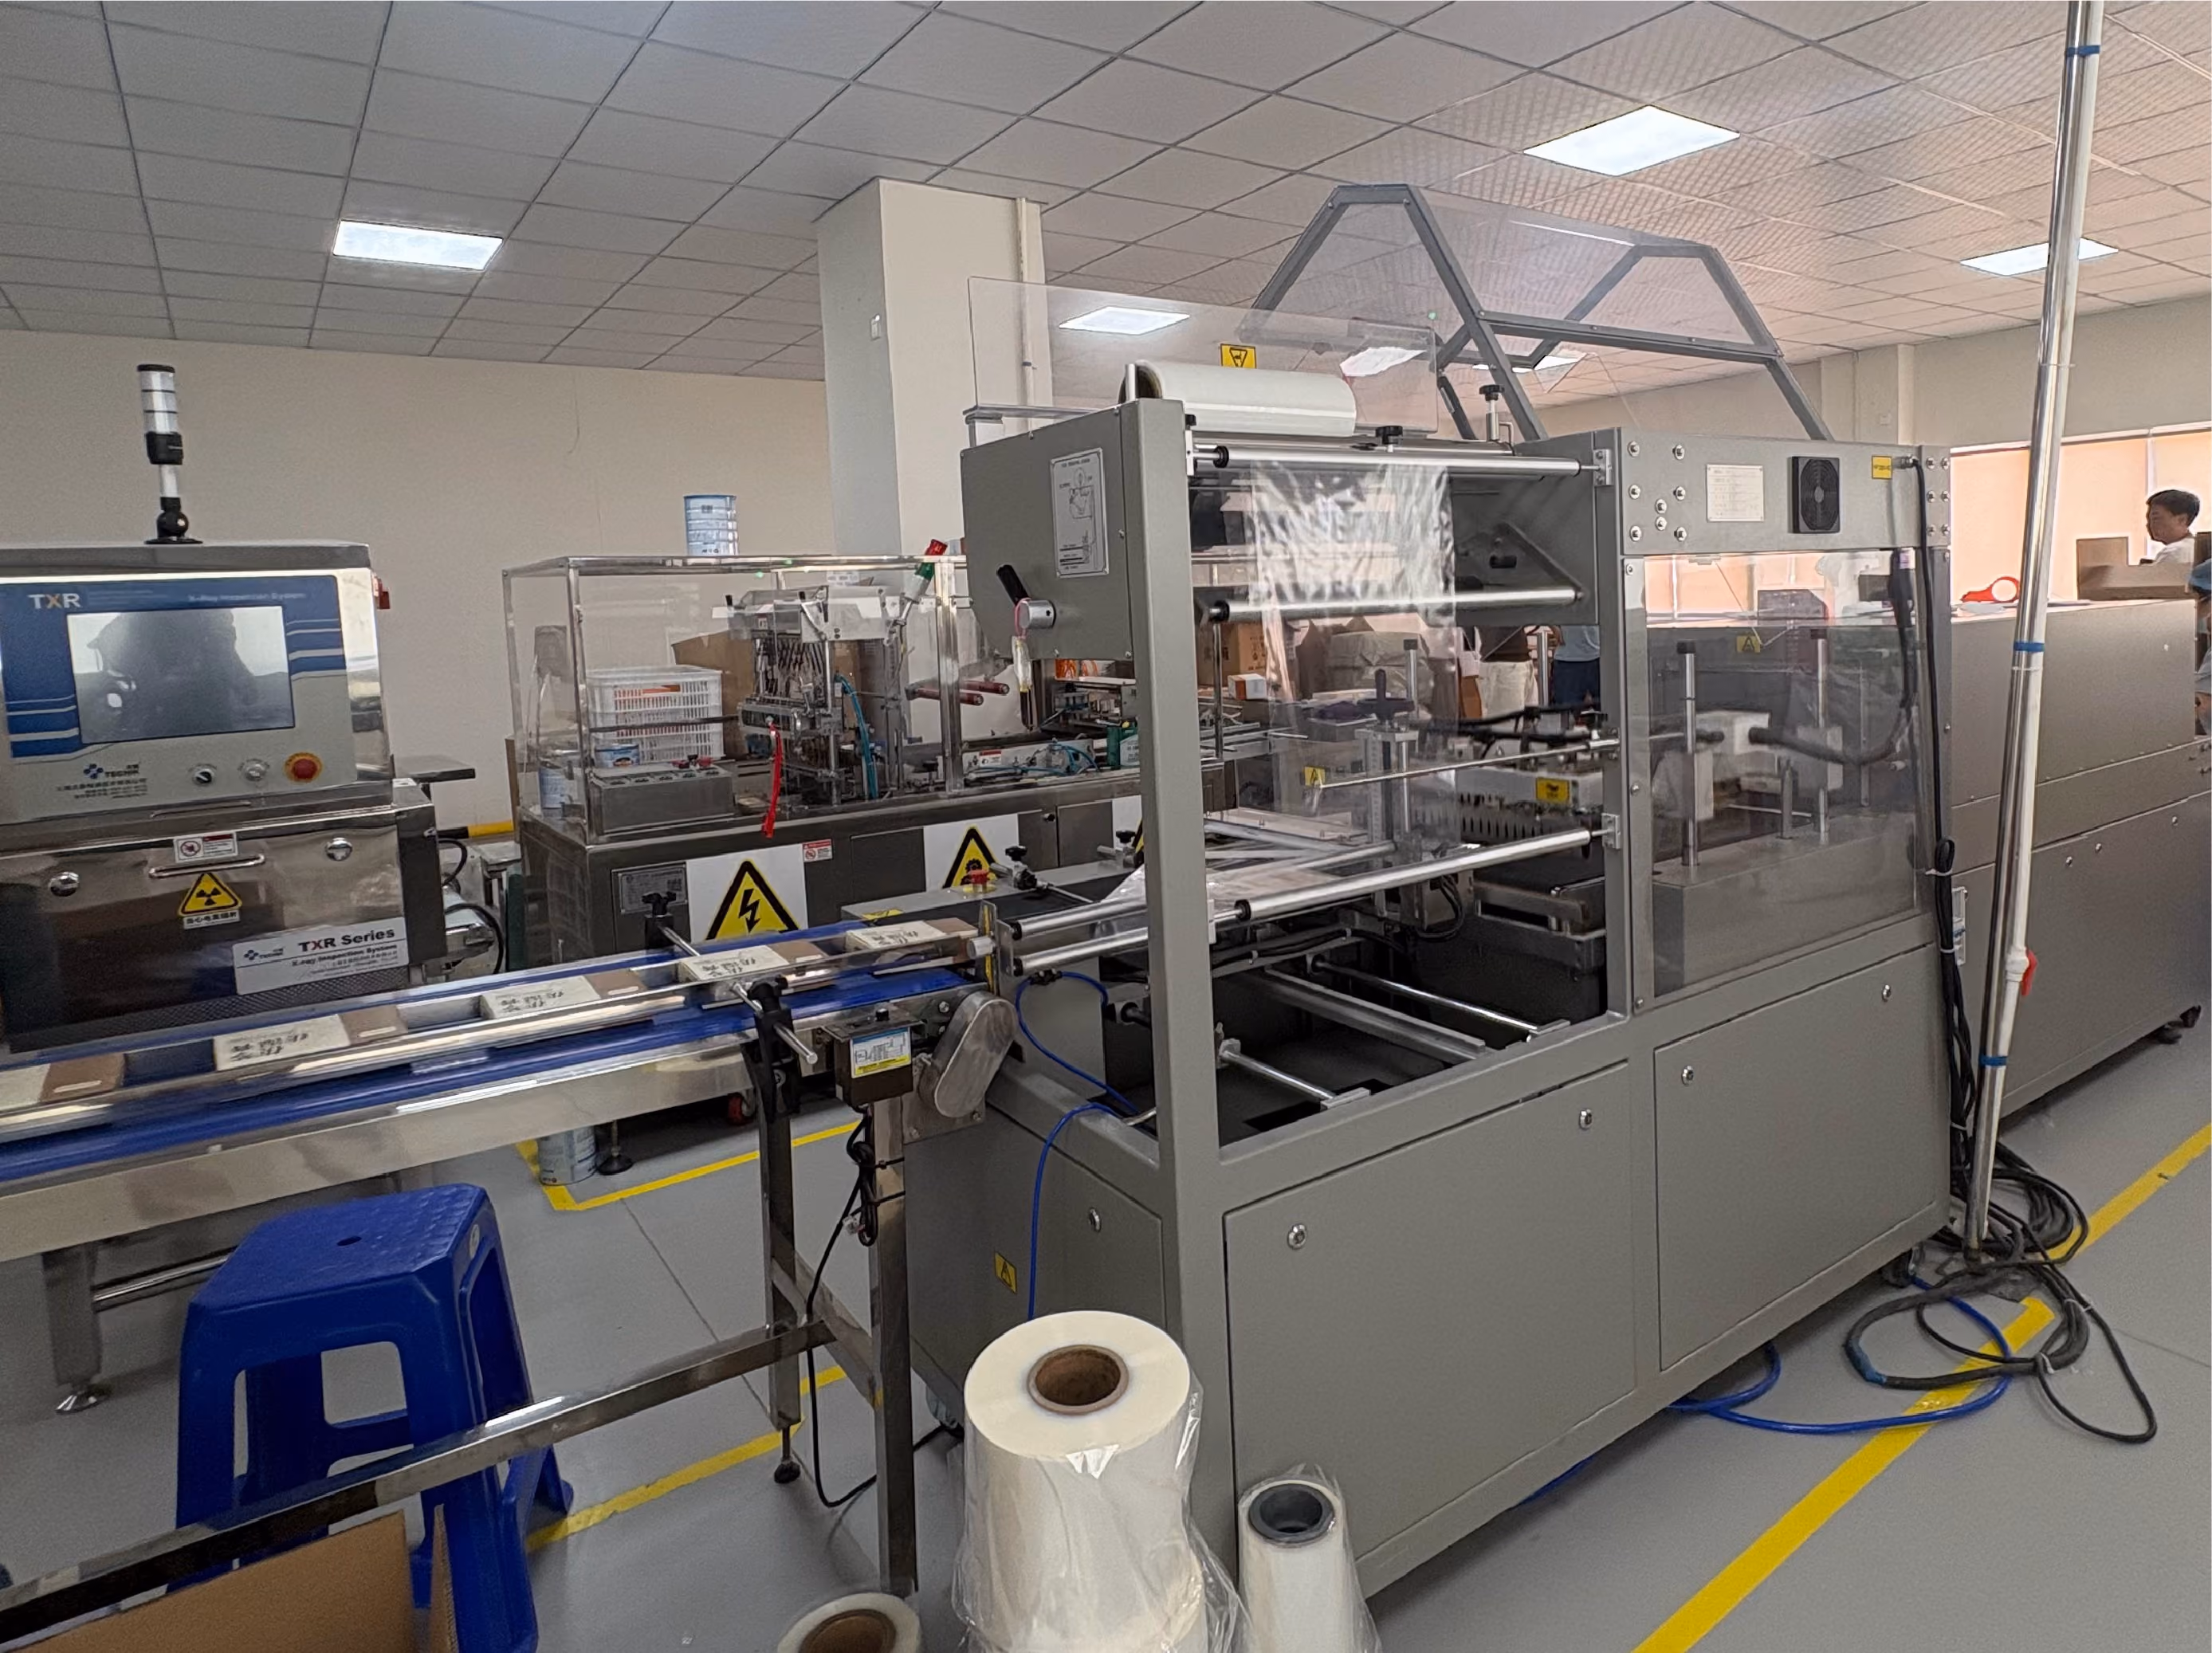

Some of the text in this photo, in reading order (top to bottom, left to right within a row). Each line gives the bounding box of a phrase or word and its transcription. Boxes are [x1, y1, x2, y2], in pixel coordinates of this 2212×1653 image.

[27, 593, 81, 609] TXR
[298, 937, 336, 952] TXR
[341, 928, 395, 946] Series
